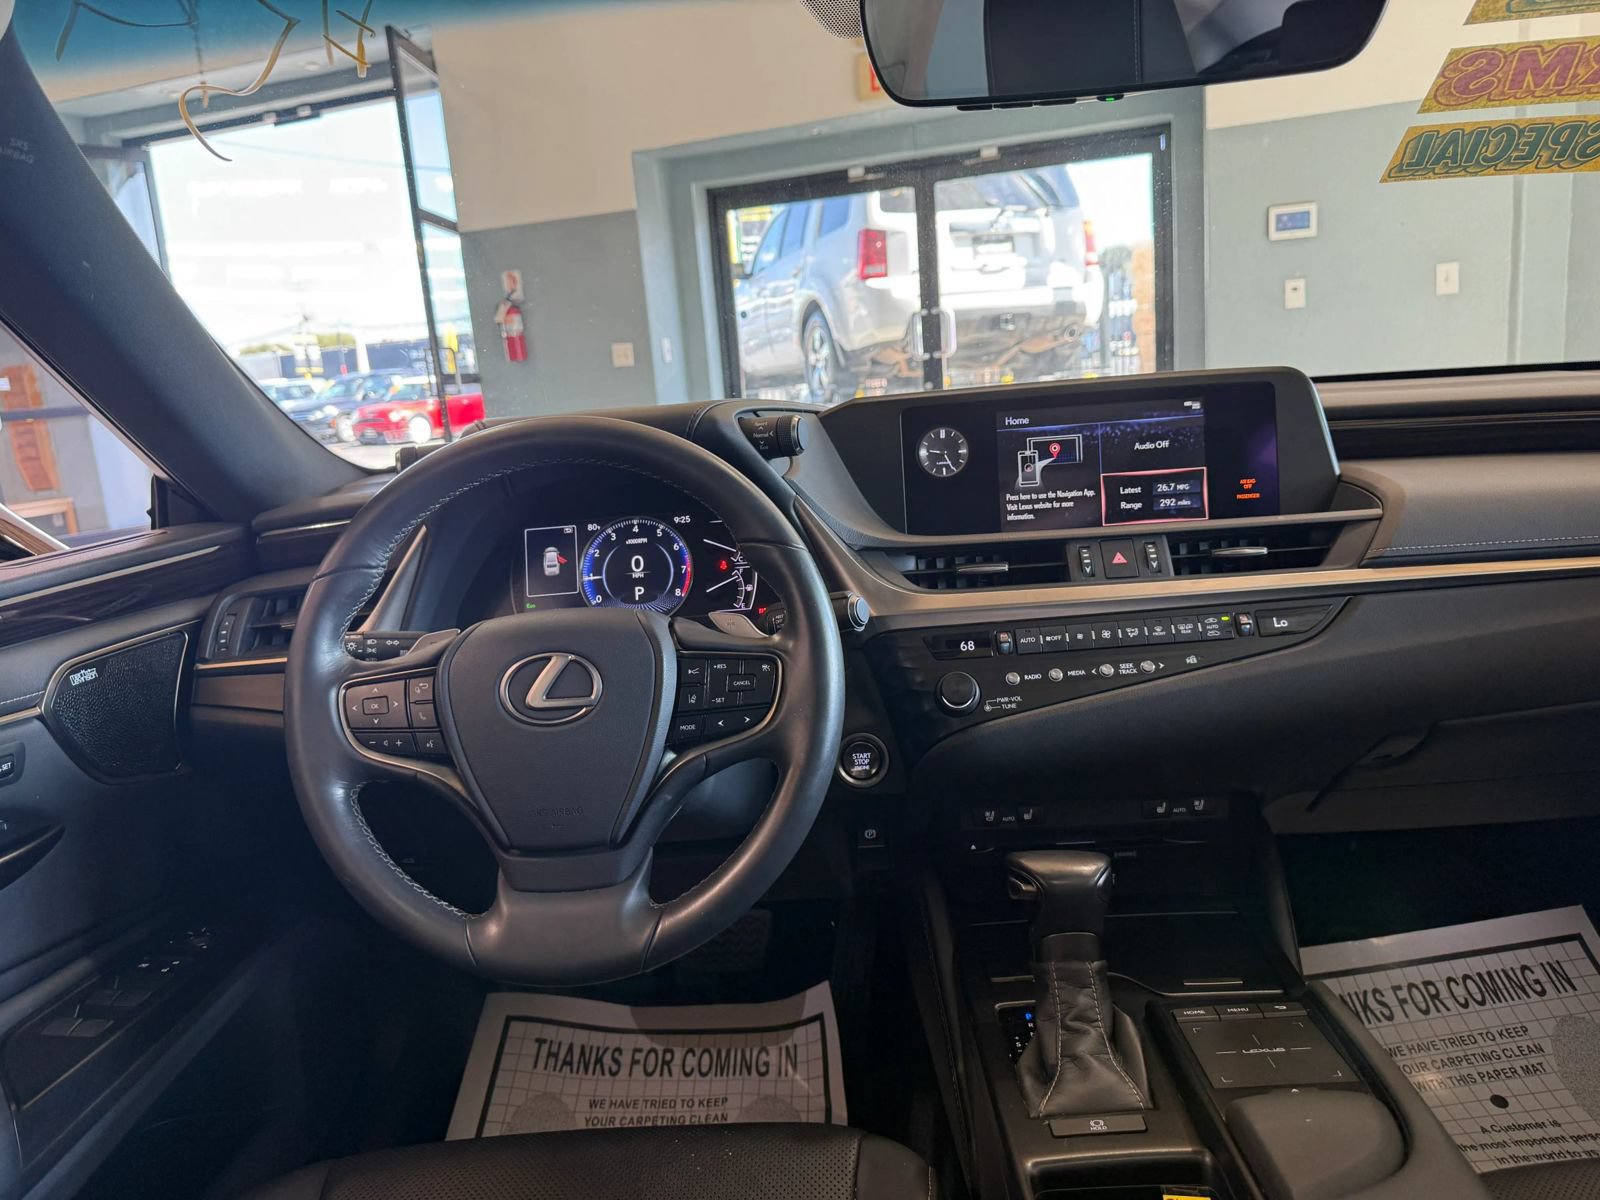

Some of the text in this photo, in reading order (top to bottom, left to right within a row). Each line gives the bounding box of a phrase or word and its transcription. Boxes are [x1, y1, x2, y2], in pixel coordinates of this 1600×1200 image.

[1005, 416, 1030, 426] Home
[1134, 441, 1170, 450] Audio Off
[1057, 490, 1082, 498] Navigation
[1084, 488, 1096, 497] App.
[1120, 486, 1142, 494] Latest
[1157, 482, 1176, 492] 26.7
[1120, 502, 1142, 510] Range
[1160, 498, 1176, 507] 292
[674, 516, 690, 524] 9:25
[610, 532, 616, 540] 3
[656, 528, 662, 536] 5
[673, 542, 680, 551] 6
[594, 549, 600, 558] 2
[631, 555, 644, 574] 0
[681, 565, 686, 574] 7
[634, 586, 644, 600] P
[675, 588, 682, 597] 8
[595, 595, 602, 604] 0
[960, 641, 975, 652] 68
[1390, 979, 1450, 1018] FOR
[1446, 964, 1547, 1010] COMING
[1543, 960, 1578, 994] IN
[1406, 1040, 1440, 1056] HAVE
[1440, 1034, 1477, 1050] TRIED
[1478, 1031, 1496, 1043] TO
[1498, 1025, 1528, 1039] KEEP
[533, 1037, 798, 1078] THANKS FOR COMING IN
[1402, 1042, 1546, 1075] OUR CARPETING CLEAN
[1447, 1073, 1478, 1086] THIS
[1478, 1066, 1520, 1082] PAPER
[1521, 1062, 1548, 1075] MAT
[589, 1097, 728, 1110] WE HAVE TRIED TO KEEP
[584, 1112, 728, 1127] YOUR CARPETING CLEAN
[1490, 1120, 1546, 1134] Customer
[1546, 1118, 1561, 1128] is
[1479, 1138, 1510, 1150] most
[1511, 1134, 1570, 1150] important
[1510, 1152, 1534, 1164] the
[1534, 1150, 1567, 1161] world
[1566, 1150, 1582, 1159] to
